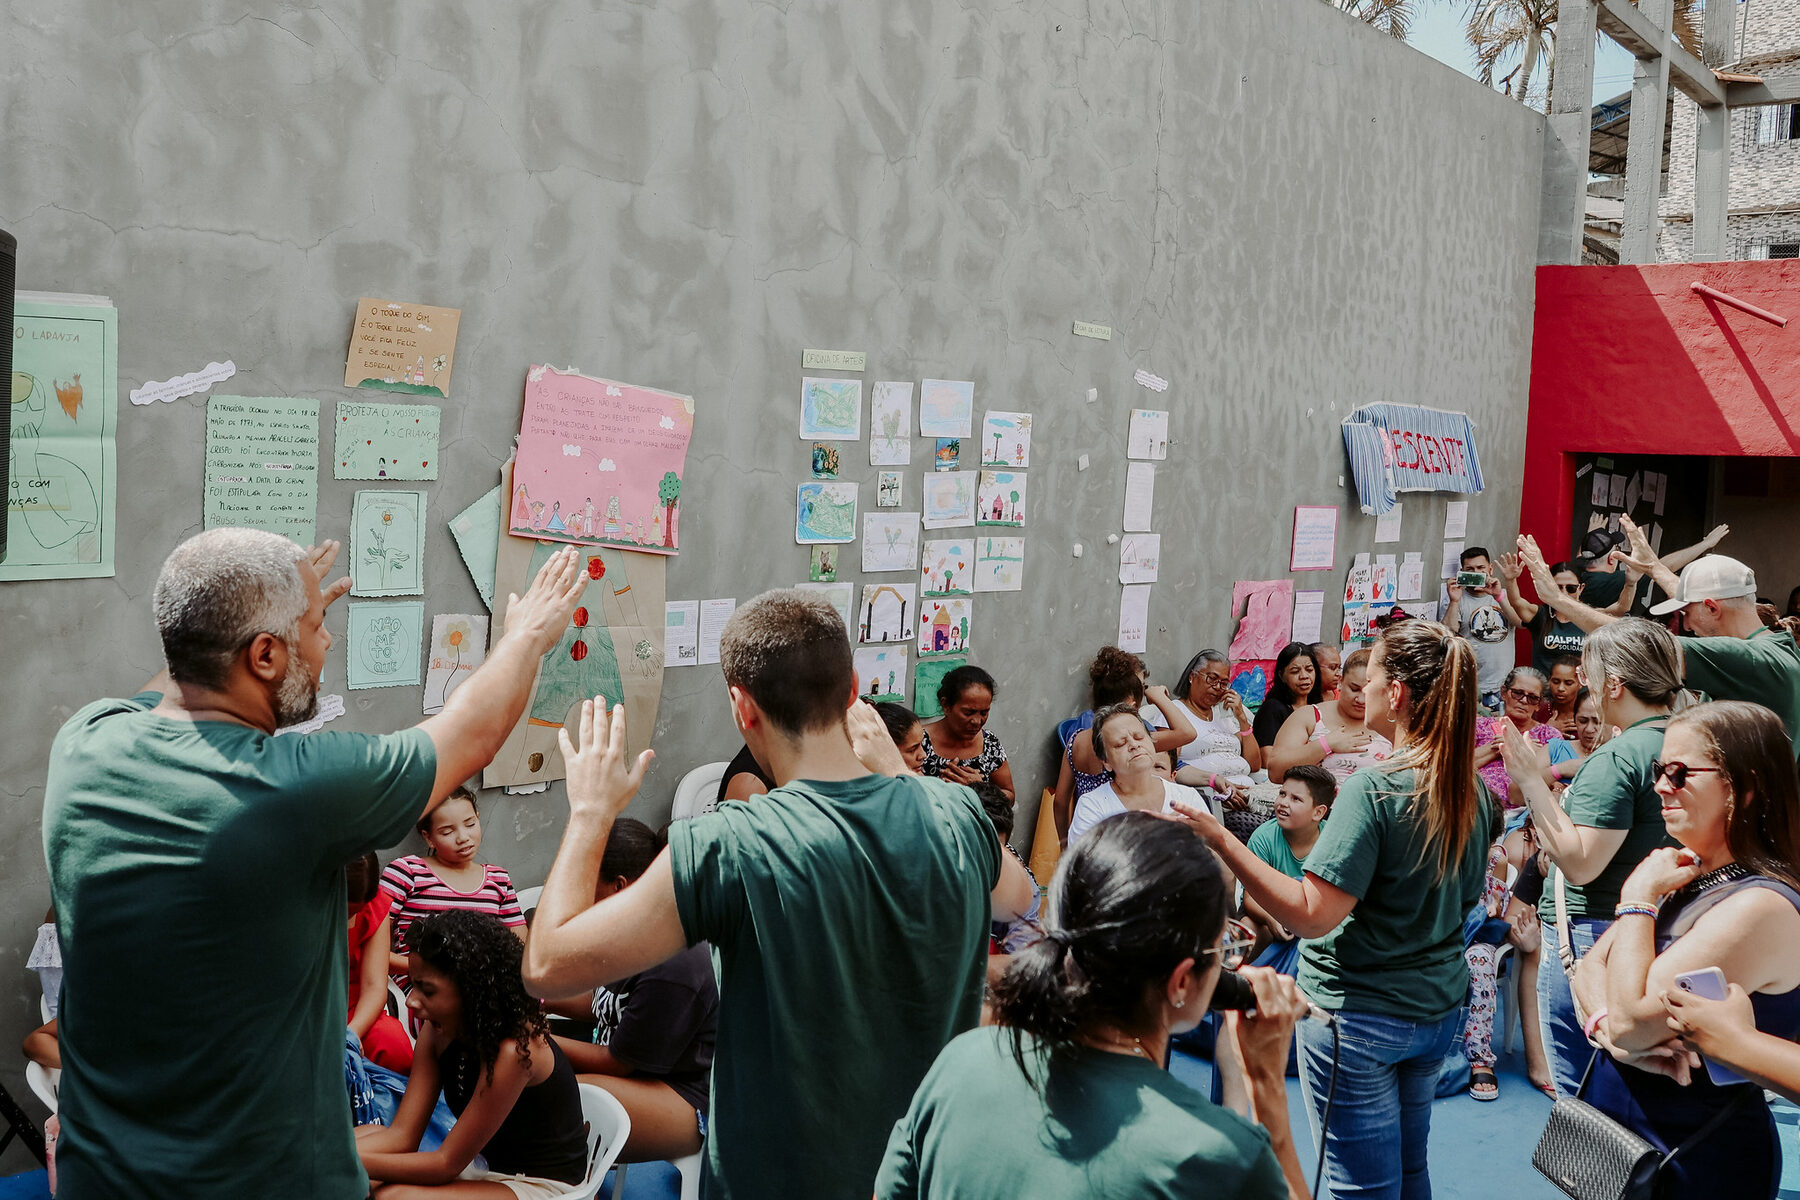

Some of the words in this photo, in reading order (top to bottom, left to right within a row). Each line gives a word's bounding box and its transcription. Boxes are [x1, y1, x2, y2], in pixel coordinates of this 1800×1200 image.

[371, 307, 378, 316] O
[381, 309, 399, 318] TOQUE
[402, 311, 412, 319] DO
[375, 321, 393, 332] TOQUE
[396, 325, 416, 334] LEGAL
[396, 338, 417, 347] FELIZ
[368, 348, 379, 356] SE
[381, 348, 405, 359] SENTE
[363, 360, 396, 372] ESPECIAL
[213, 403, 218, 411] A
[340, 403, 379, 417] PROTEJA
[392, 409, 417, 418] NOSSO
[28, 479, 51, 489] COM
[208, 473, 213, 483] E
[209, 485, 223, 497] FOI
[375, 632, 396, 647] ME
